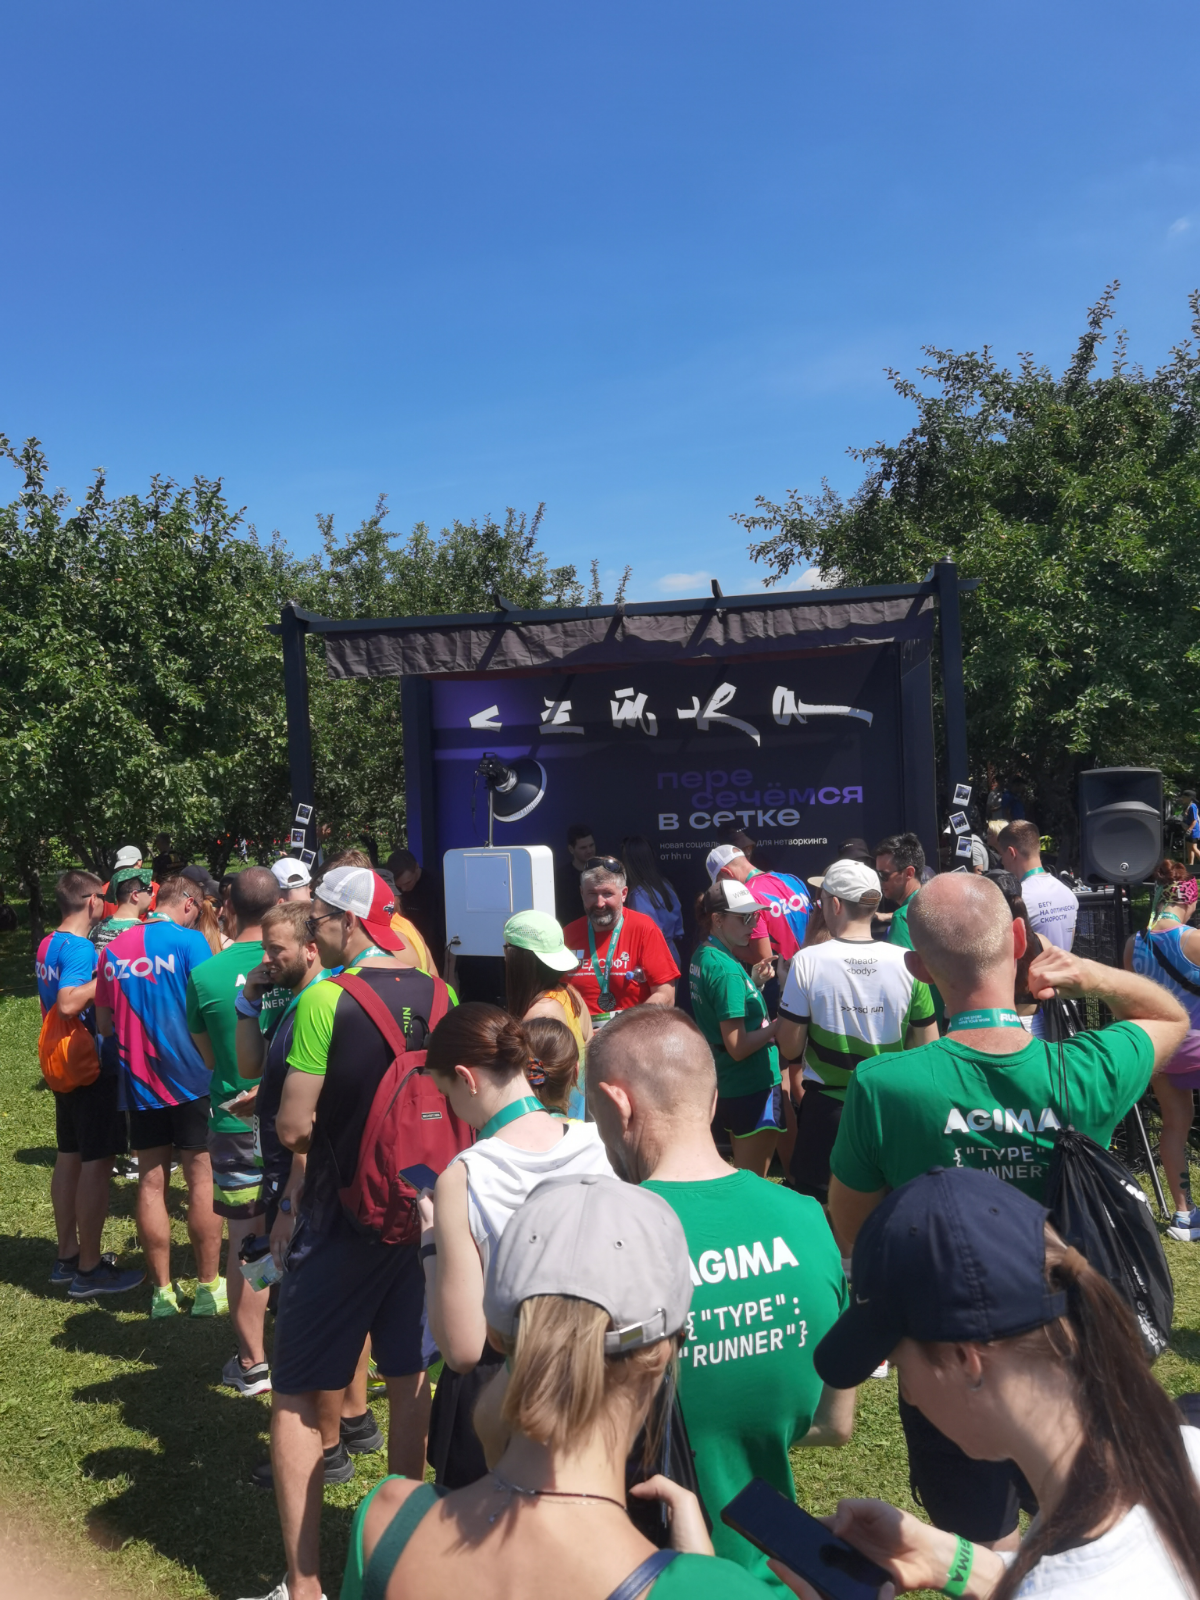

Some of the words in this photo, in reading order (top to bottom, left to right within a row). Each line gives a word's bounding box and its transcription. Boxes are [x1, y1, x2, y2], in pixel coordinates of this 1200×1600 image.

[657, 768, 753, 794] пере
[691, 782, 863, 810] сечёмся
[689, 808, 801, 830] сетке
[660, 842, 685, 850] новая
[685, 841, 721, 850] социаль
[756, 839, 773, 848] для
[774, 837, 828, 847] нетворкинга
[770, 893, 809, 918] OZON
[1040, 914, 1067, 924] СКОРОСТИ
[35, 961, 59, 982] ZON
[103, 953, 175, 982] OZON
[944, 1107, 1061, 1134] AGIMA
[951, 1537, 971, 1583] GIMA
